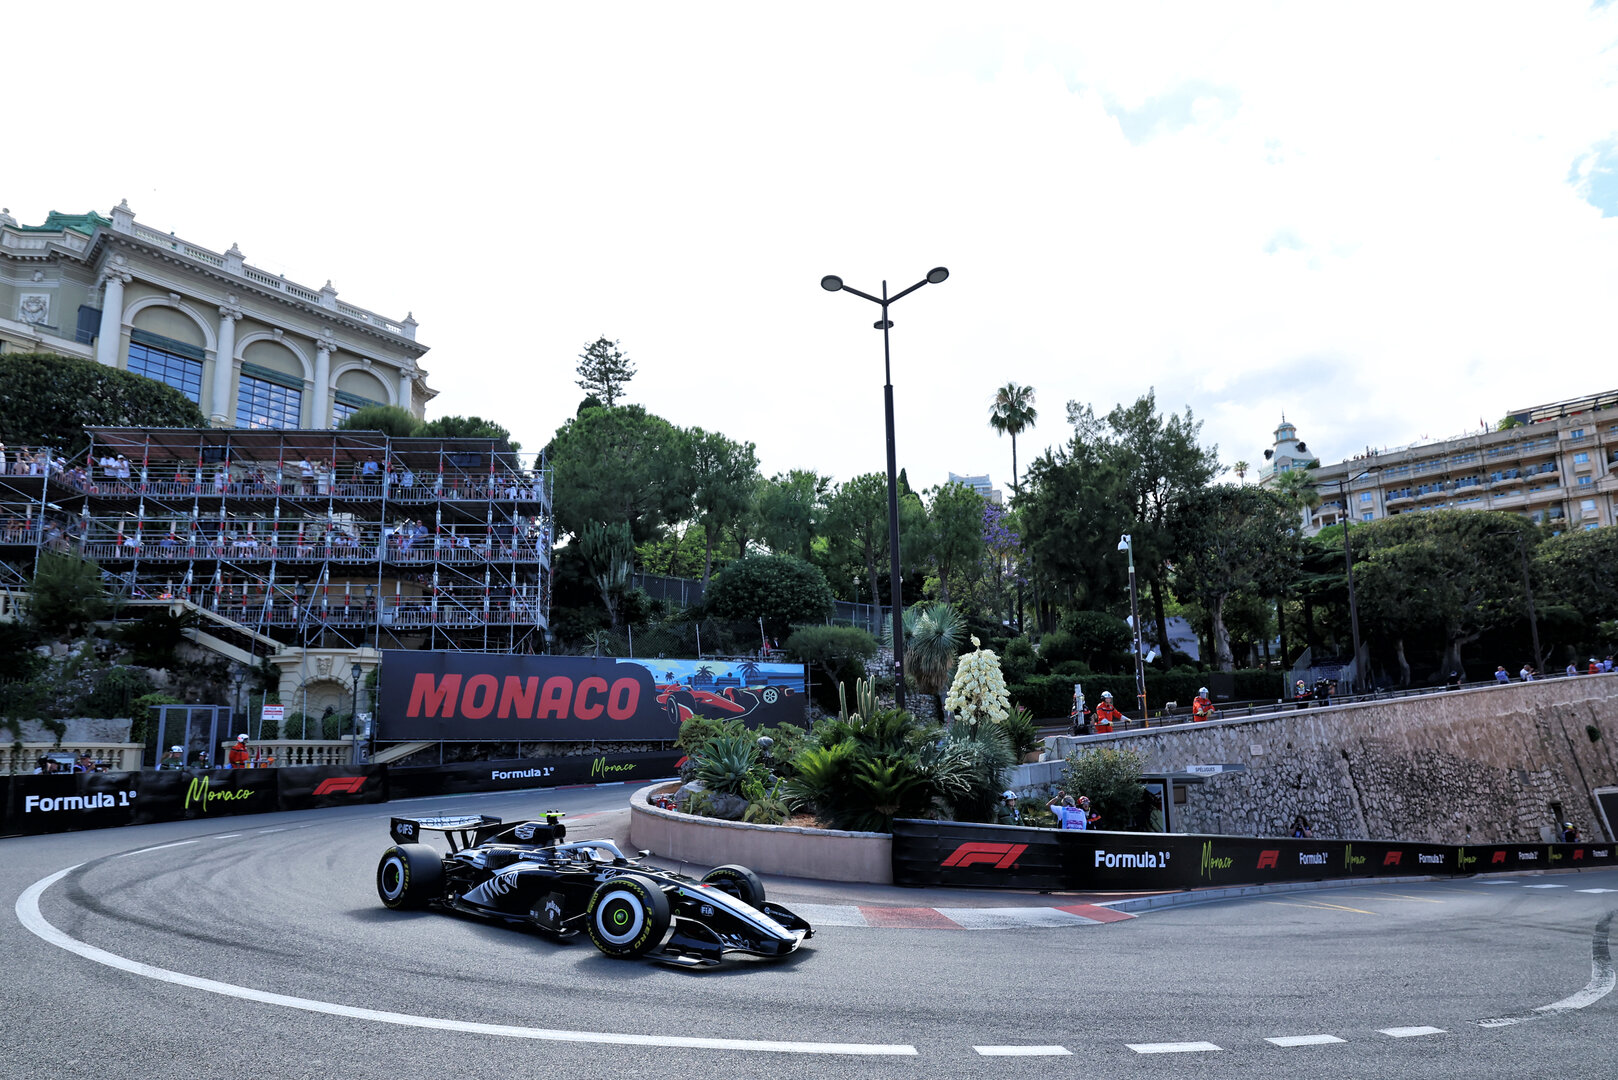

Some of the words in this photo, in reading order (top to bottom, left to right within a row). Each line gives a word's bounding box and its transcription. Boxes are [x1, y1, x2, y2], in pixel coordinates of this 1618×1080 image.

[406, 673, 641, 720] MONACO
[491, 767, 542, 780] Formula
[591, 756, 637, 778] Monaco
[25, 792, 115, 813] Formula
[184, 775, 255, 812] Monaco
[1094, 850, 1157, 868] Formula
[1201, 840, 1234, 880] Monaco
[1299, 852, 1322, 864] Formula
[1344, 843, 1366, 872] Monaco
[1418, 853, 1439, 863] Formula
[646, 906, 653, 915] P
[634, 917, 653, 949] ZERO
